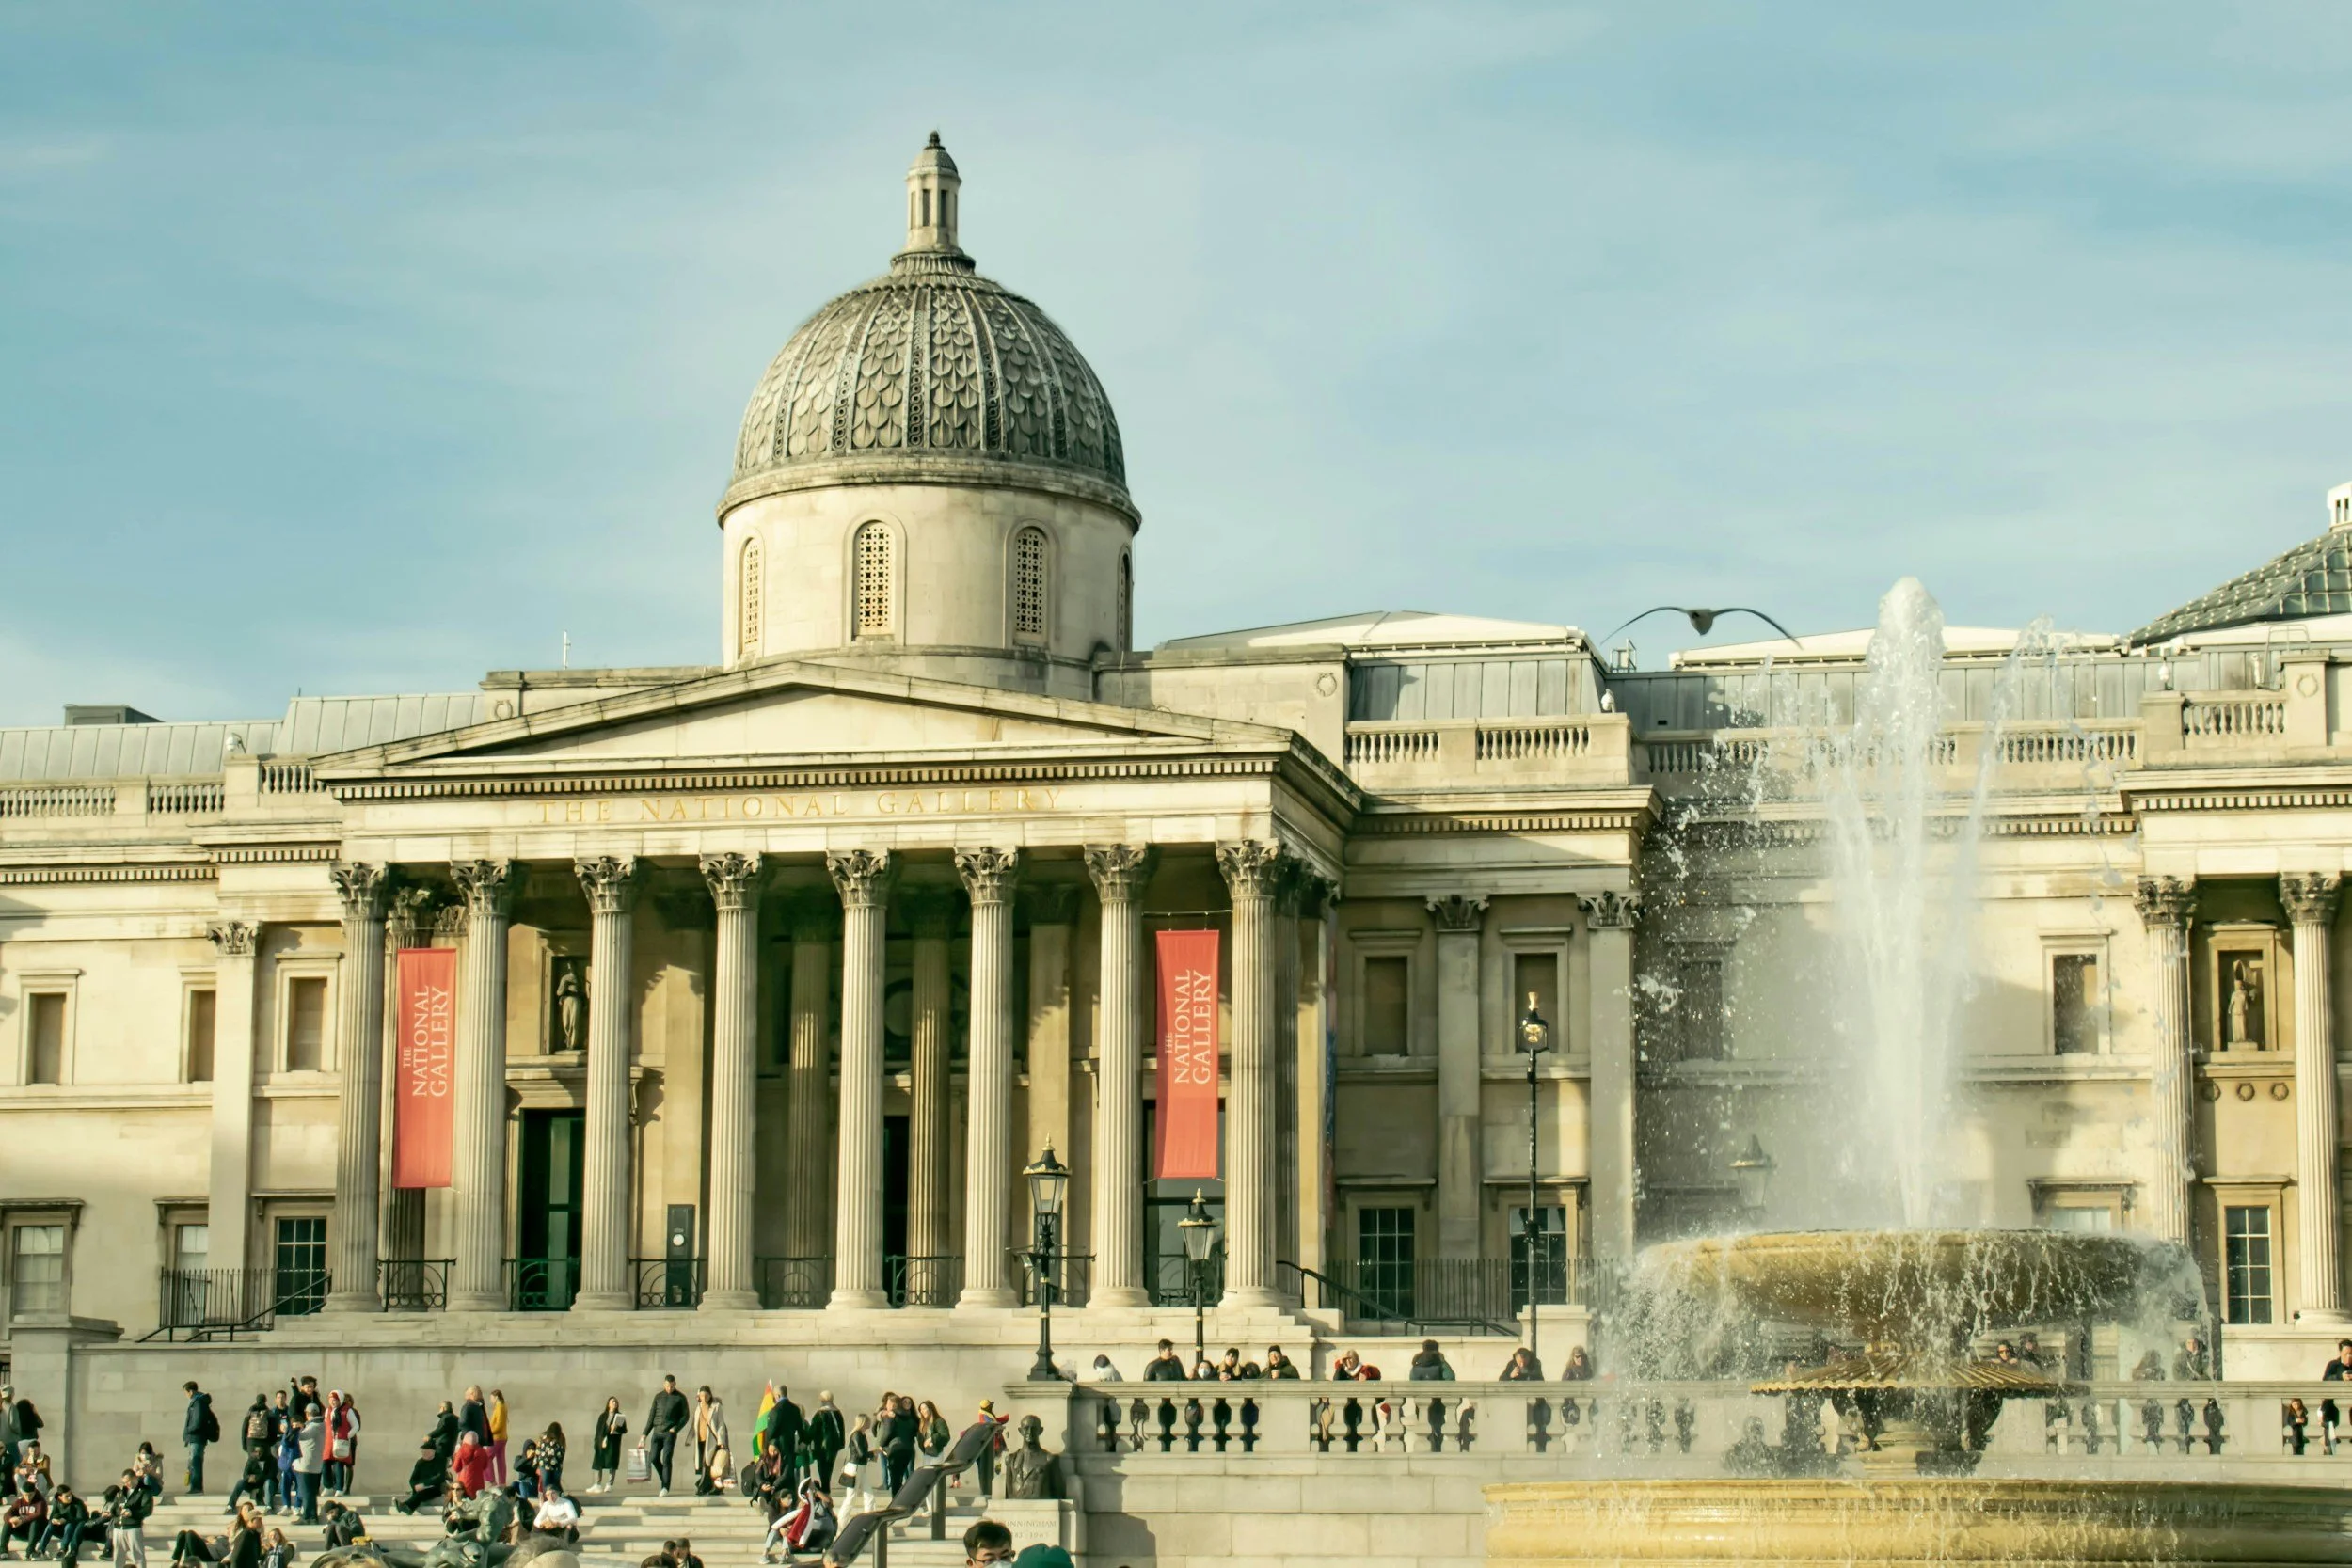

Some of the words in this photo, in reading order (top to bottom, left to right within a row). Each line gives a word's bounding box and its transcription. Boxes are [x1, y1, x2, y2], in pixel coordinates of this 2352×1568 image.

[535, 801, 612, 824] THE
[640, 793, 850, 821] NATIONAL
[876, 787, 1062, 815] GALLERY
[403, 1046, 412, 1069] THE
[412, 985, 430, 1097] NATIONAL
[430, 986, 449, 1098] GALLERY
[1165, 1032, 1173, 1054] THE
[1174, 969, 1191, 1085] NATIONAL
[1192, 969, 1211, 1085] GALLERY
